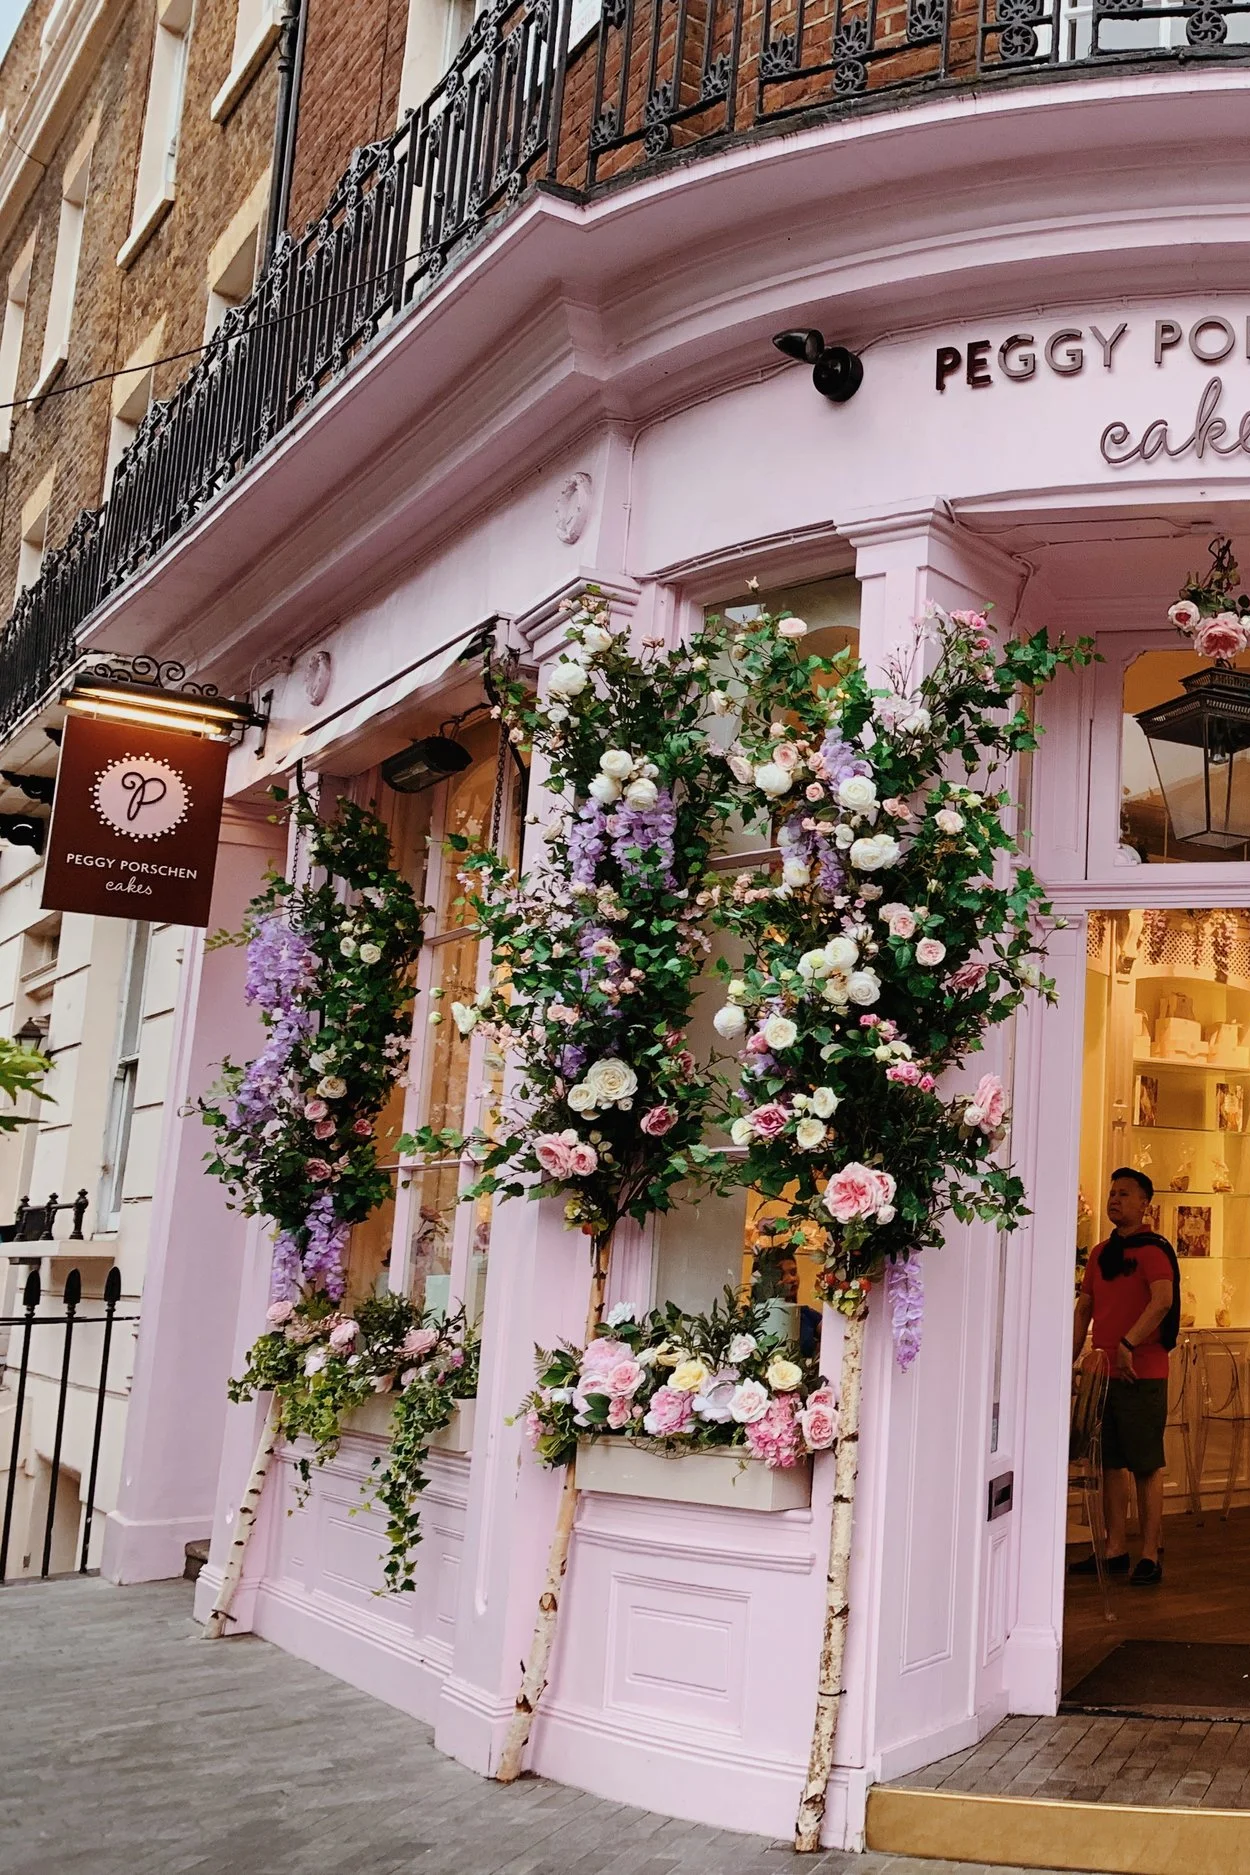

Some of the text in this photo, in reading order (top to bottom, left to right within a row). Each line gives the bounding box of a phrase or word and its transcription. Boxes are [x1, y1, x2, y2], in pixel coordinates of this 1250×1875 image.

[936, 322, 1128, 391] PEGGY
[66, 853, 198, 880] PEGGY PORSCHEN
[105, 876, 153, 895] cakes
